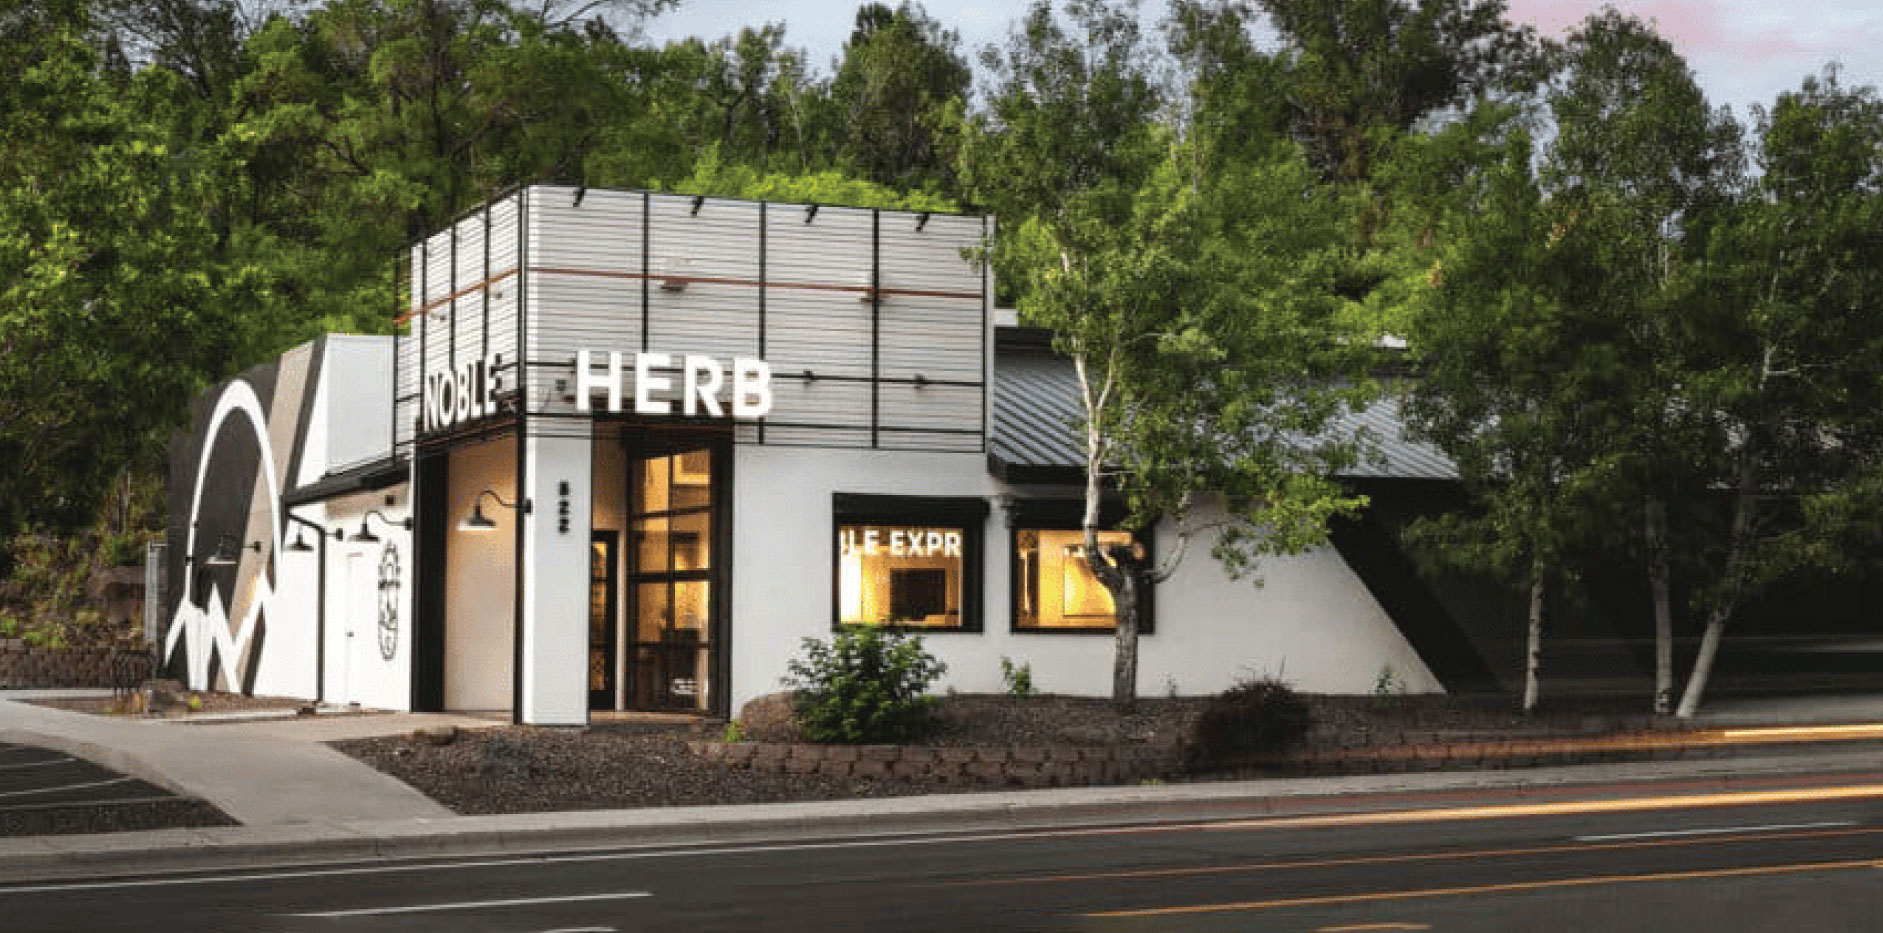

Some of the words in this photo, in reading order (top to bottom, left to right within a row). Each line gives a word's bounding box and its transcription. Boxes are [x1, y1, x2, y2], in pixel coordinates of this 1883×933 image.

[423, 354, 503, 432] NOBLE
[576, 349, 773, 418] HERB
[890, 530, 961, 558] EXPR
